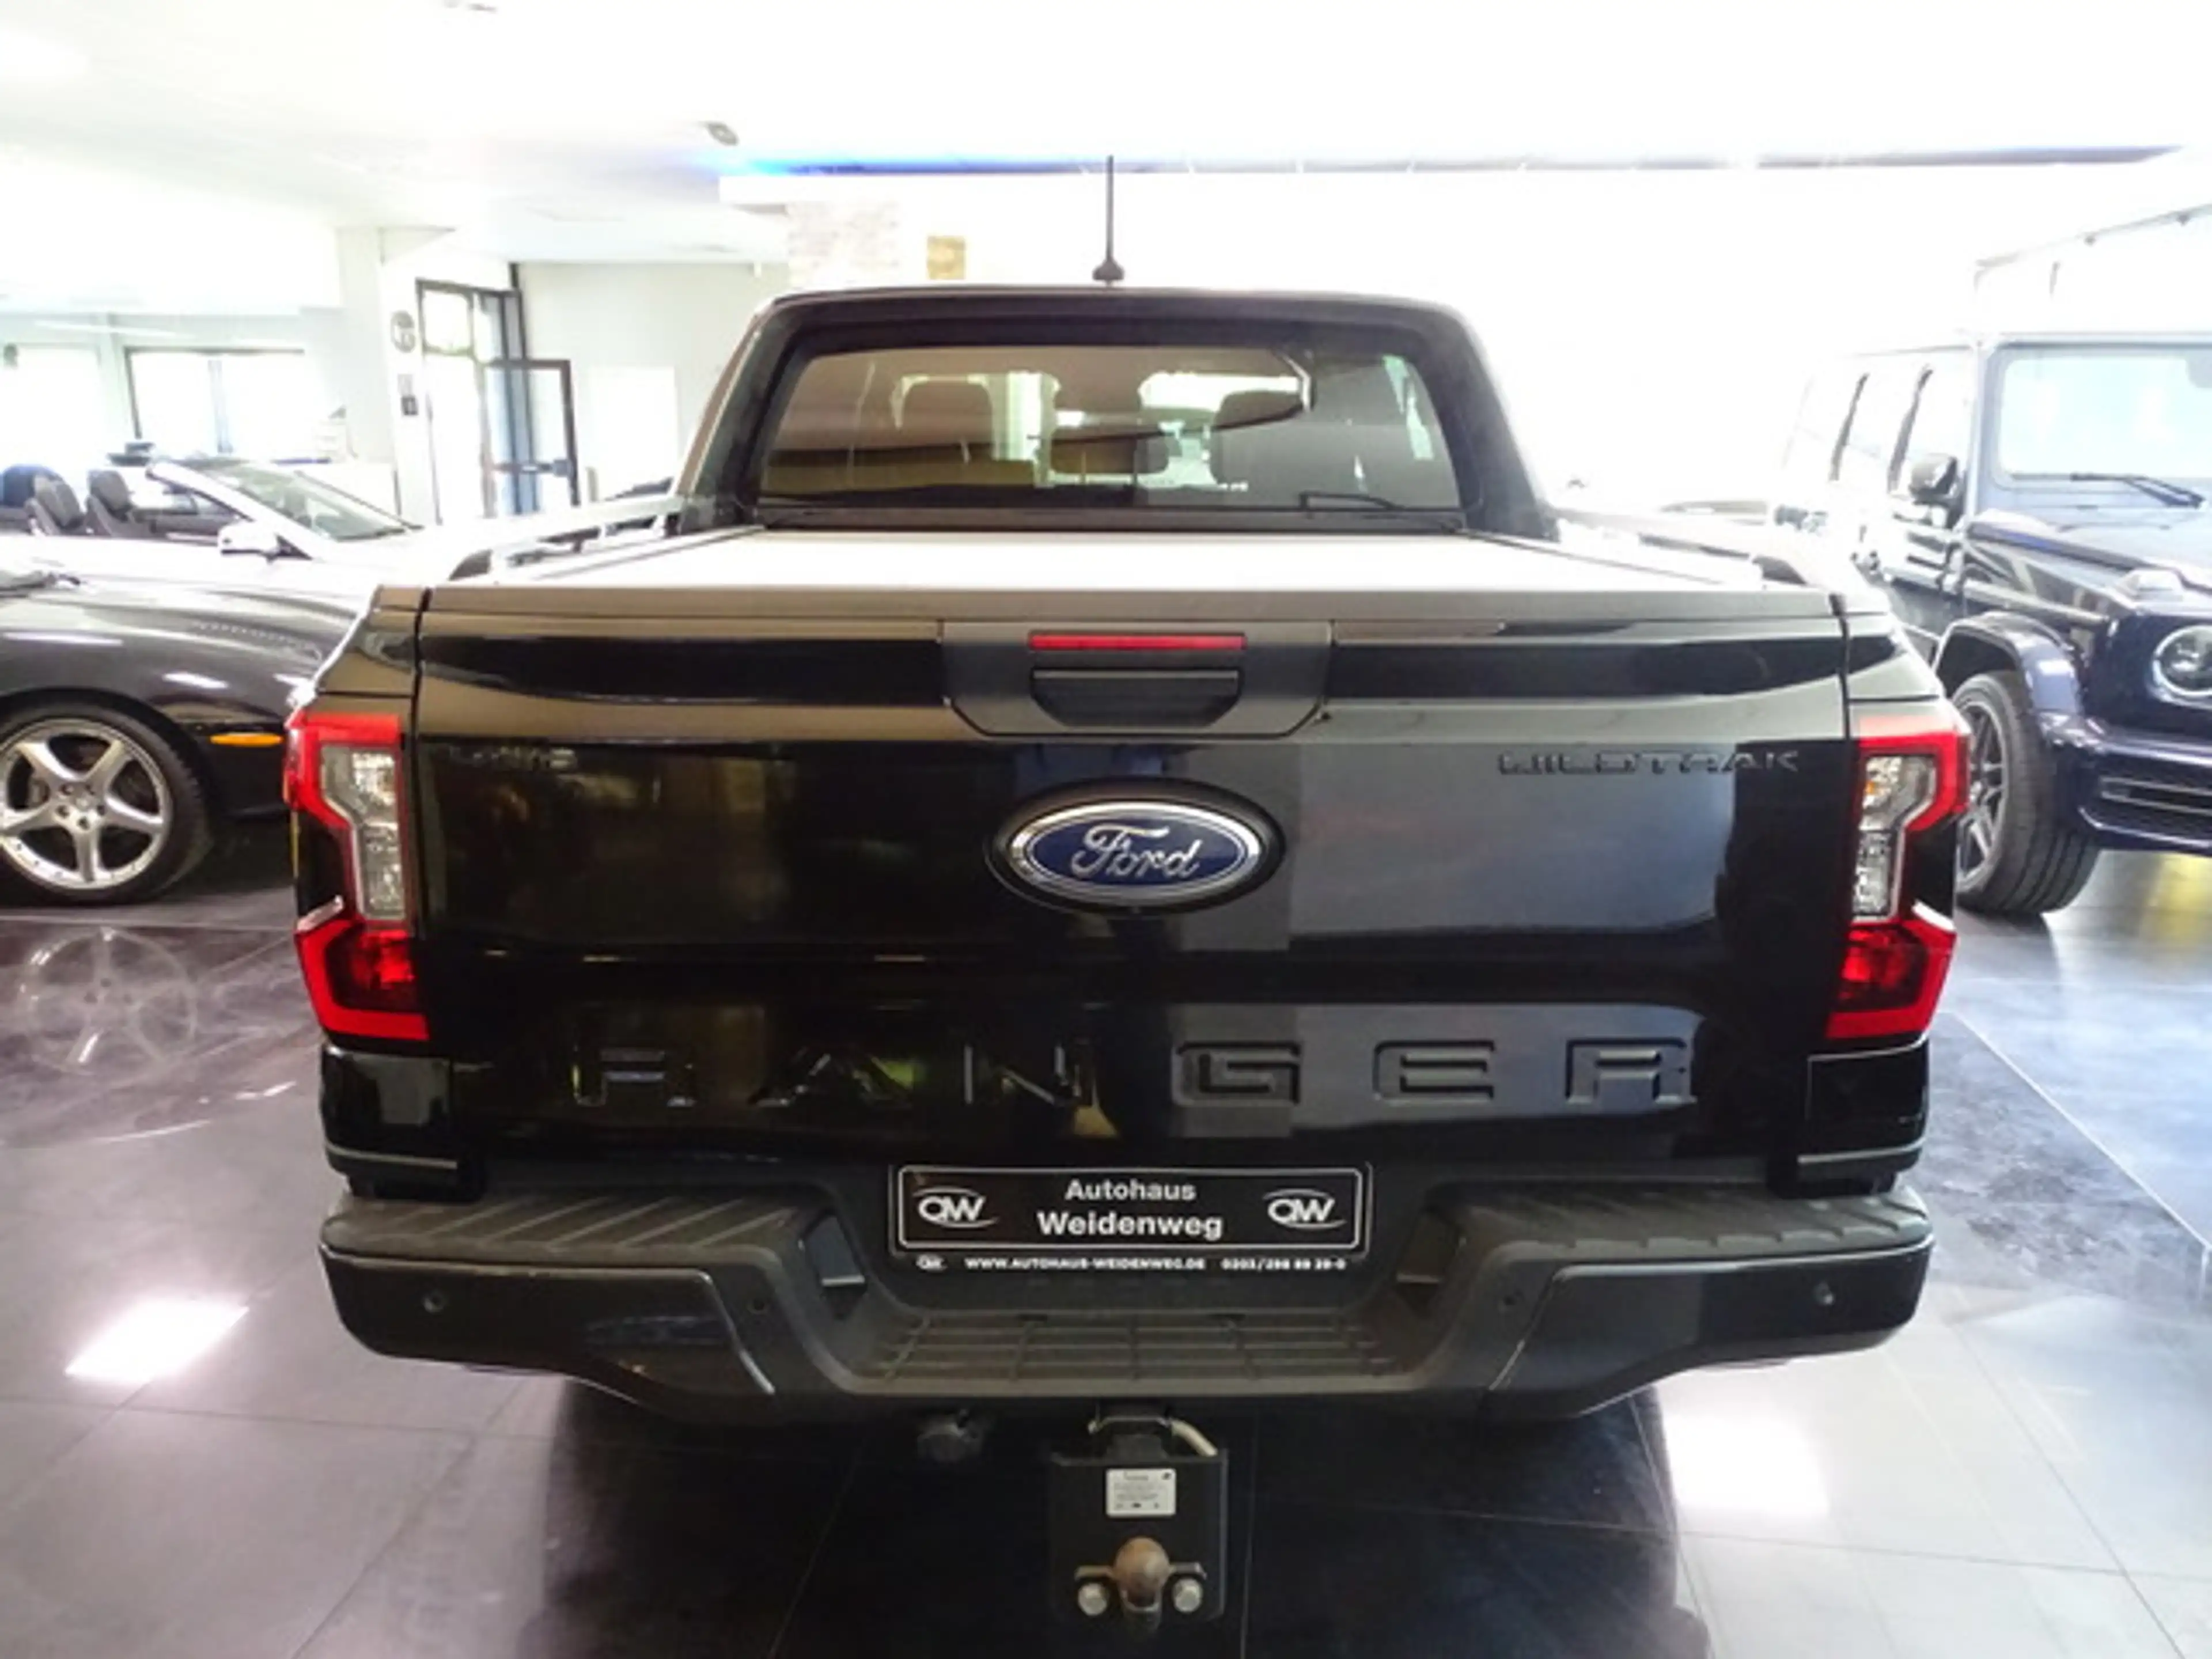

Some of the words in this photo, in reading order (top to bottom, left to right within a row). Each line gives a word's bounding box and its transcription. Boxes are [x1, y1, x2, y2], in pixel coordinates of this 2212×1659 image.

[1499, 750, 1800, 775] WILDTRAK
[1071, 823, 1204, 877] Ford
[572, 1040, 1696, 1108] RANGER
[1065, 1178, 1196, 1200] Autohaus
[1037, 1211, 1223, 1240] Weidenweg
